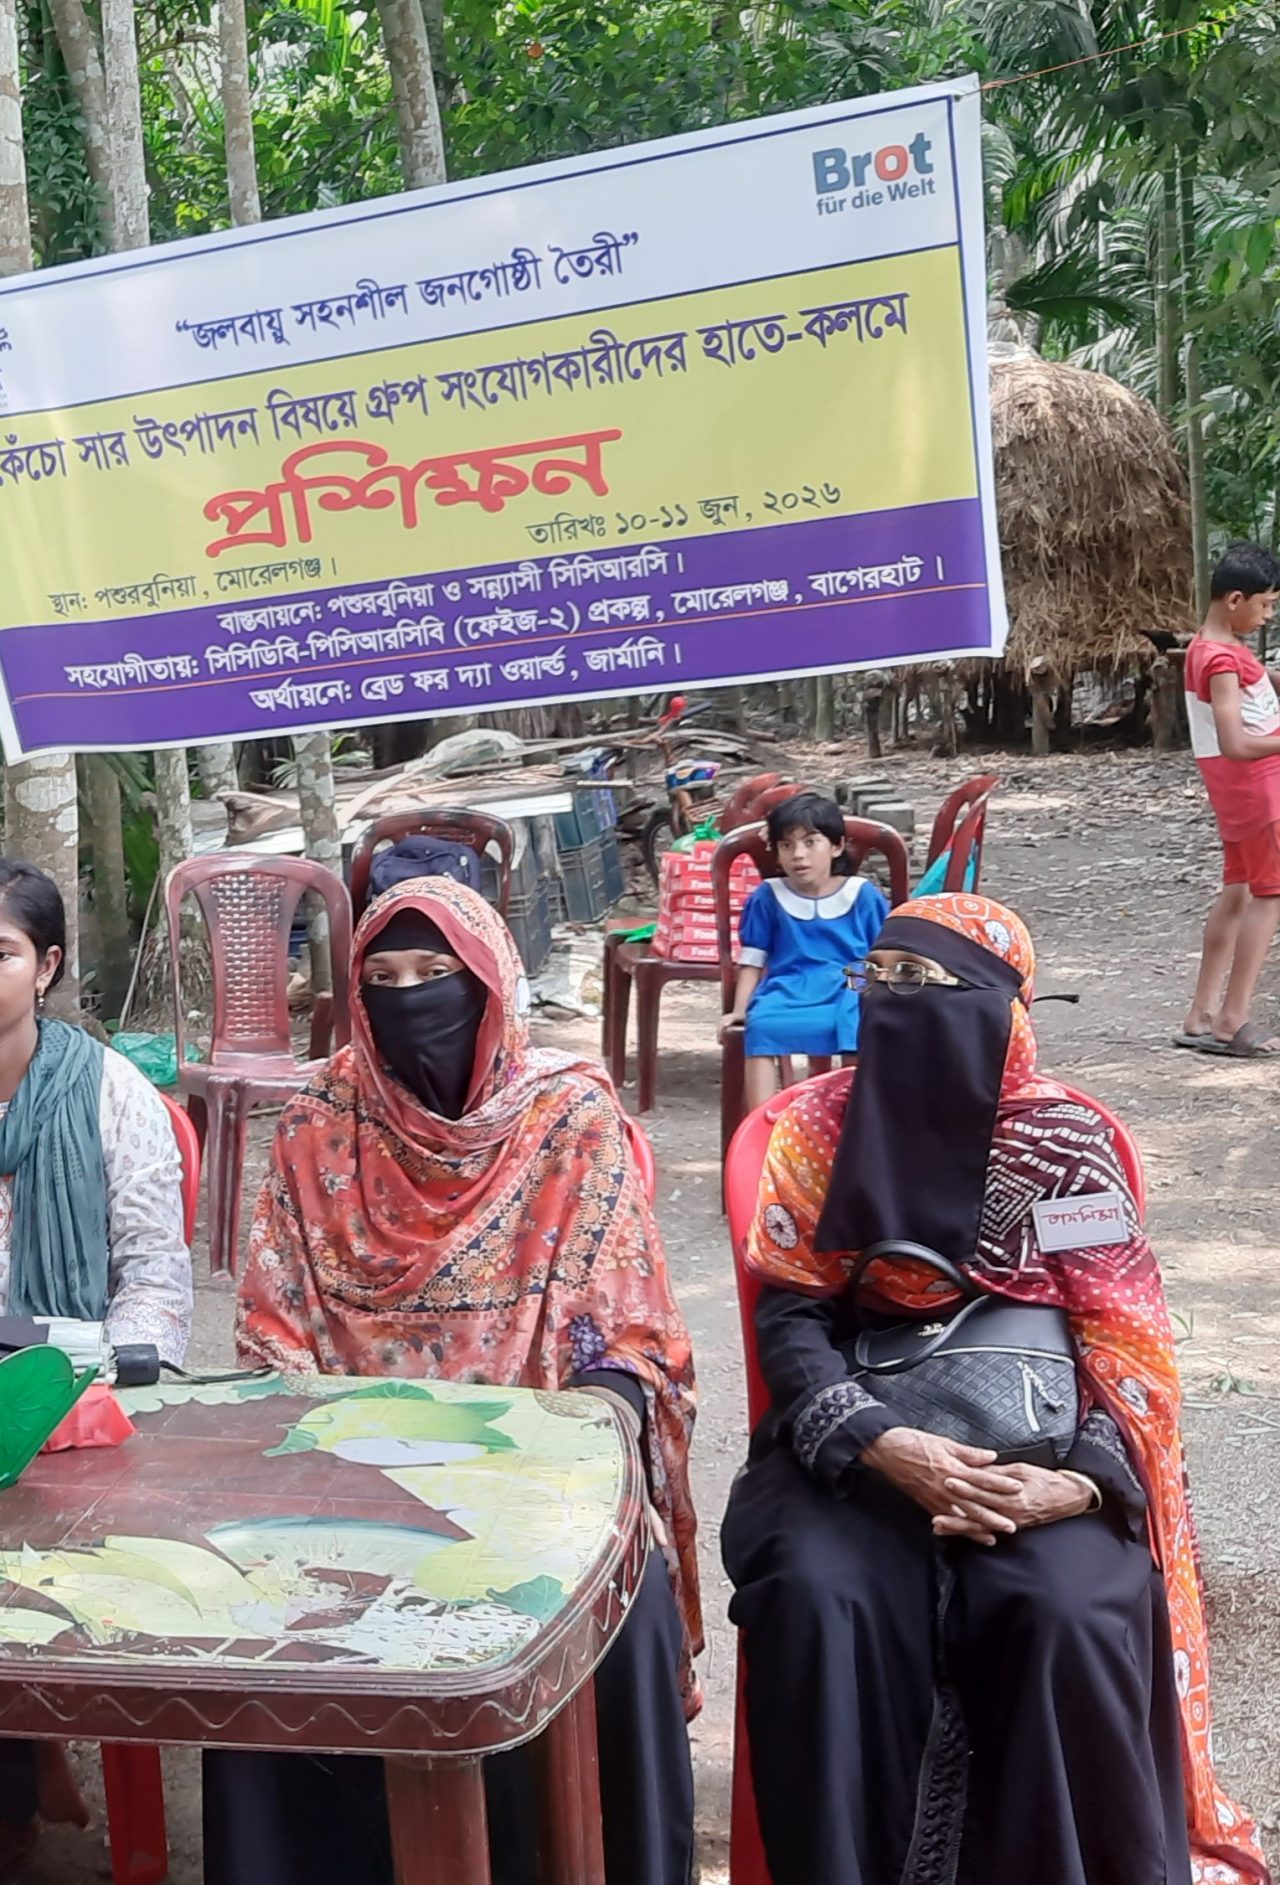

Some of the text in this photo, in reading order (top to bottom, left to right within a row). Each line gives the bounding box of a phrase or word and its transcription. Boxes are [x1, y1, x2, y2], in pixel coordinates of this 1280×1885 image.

[812, 132, 934, 195] Brot
[816, 178, 936, 216] für die Welt
[295, 277, 408, 332] সহনশীল
[414, 246, 544, 308] জনগোষ্ঠী
[77, 430, 130, 471] সার
[133, 406, 261, 460] উৎপাদন
[263, 387, 359, 442] বিষয়ে
[364, 373, 430, 425] গ্রুপ
[433, 327, 690, 411] সংযোগকারীদের
[694, 291, 911, 369] হাতে-কলমে
[203, 427, 623, 557] প্রশিক্ষন
[614, 503, 689, 536] ১০-১১
[762, 481, 842, 515] ২০২৬
[326, 580, 435, 619] পশুরবুনিয়া
[440, 581, 462, 602] ও
[205, 616, 445, 675] সিসিডিবি-পিসিআরসিবি
[453, 601, 581, 648] (ফেইজ-২)
[359, 673, 406, 702] ব্রেড
[408, 667, 450, 694] ফর
[453, 661, 493, 689] দ্যা
